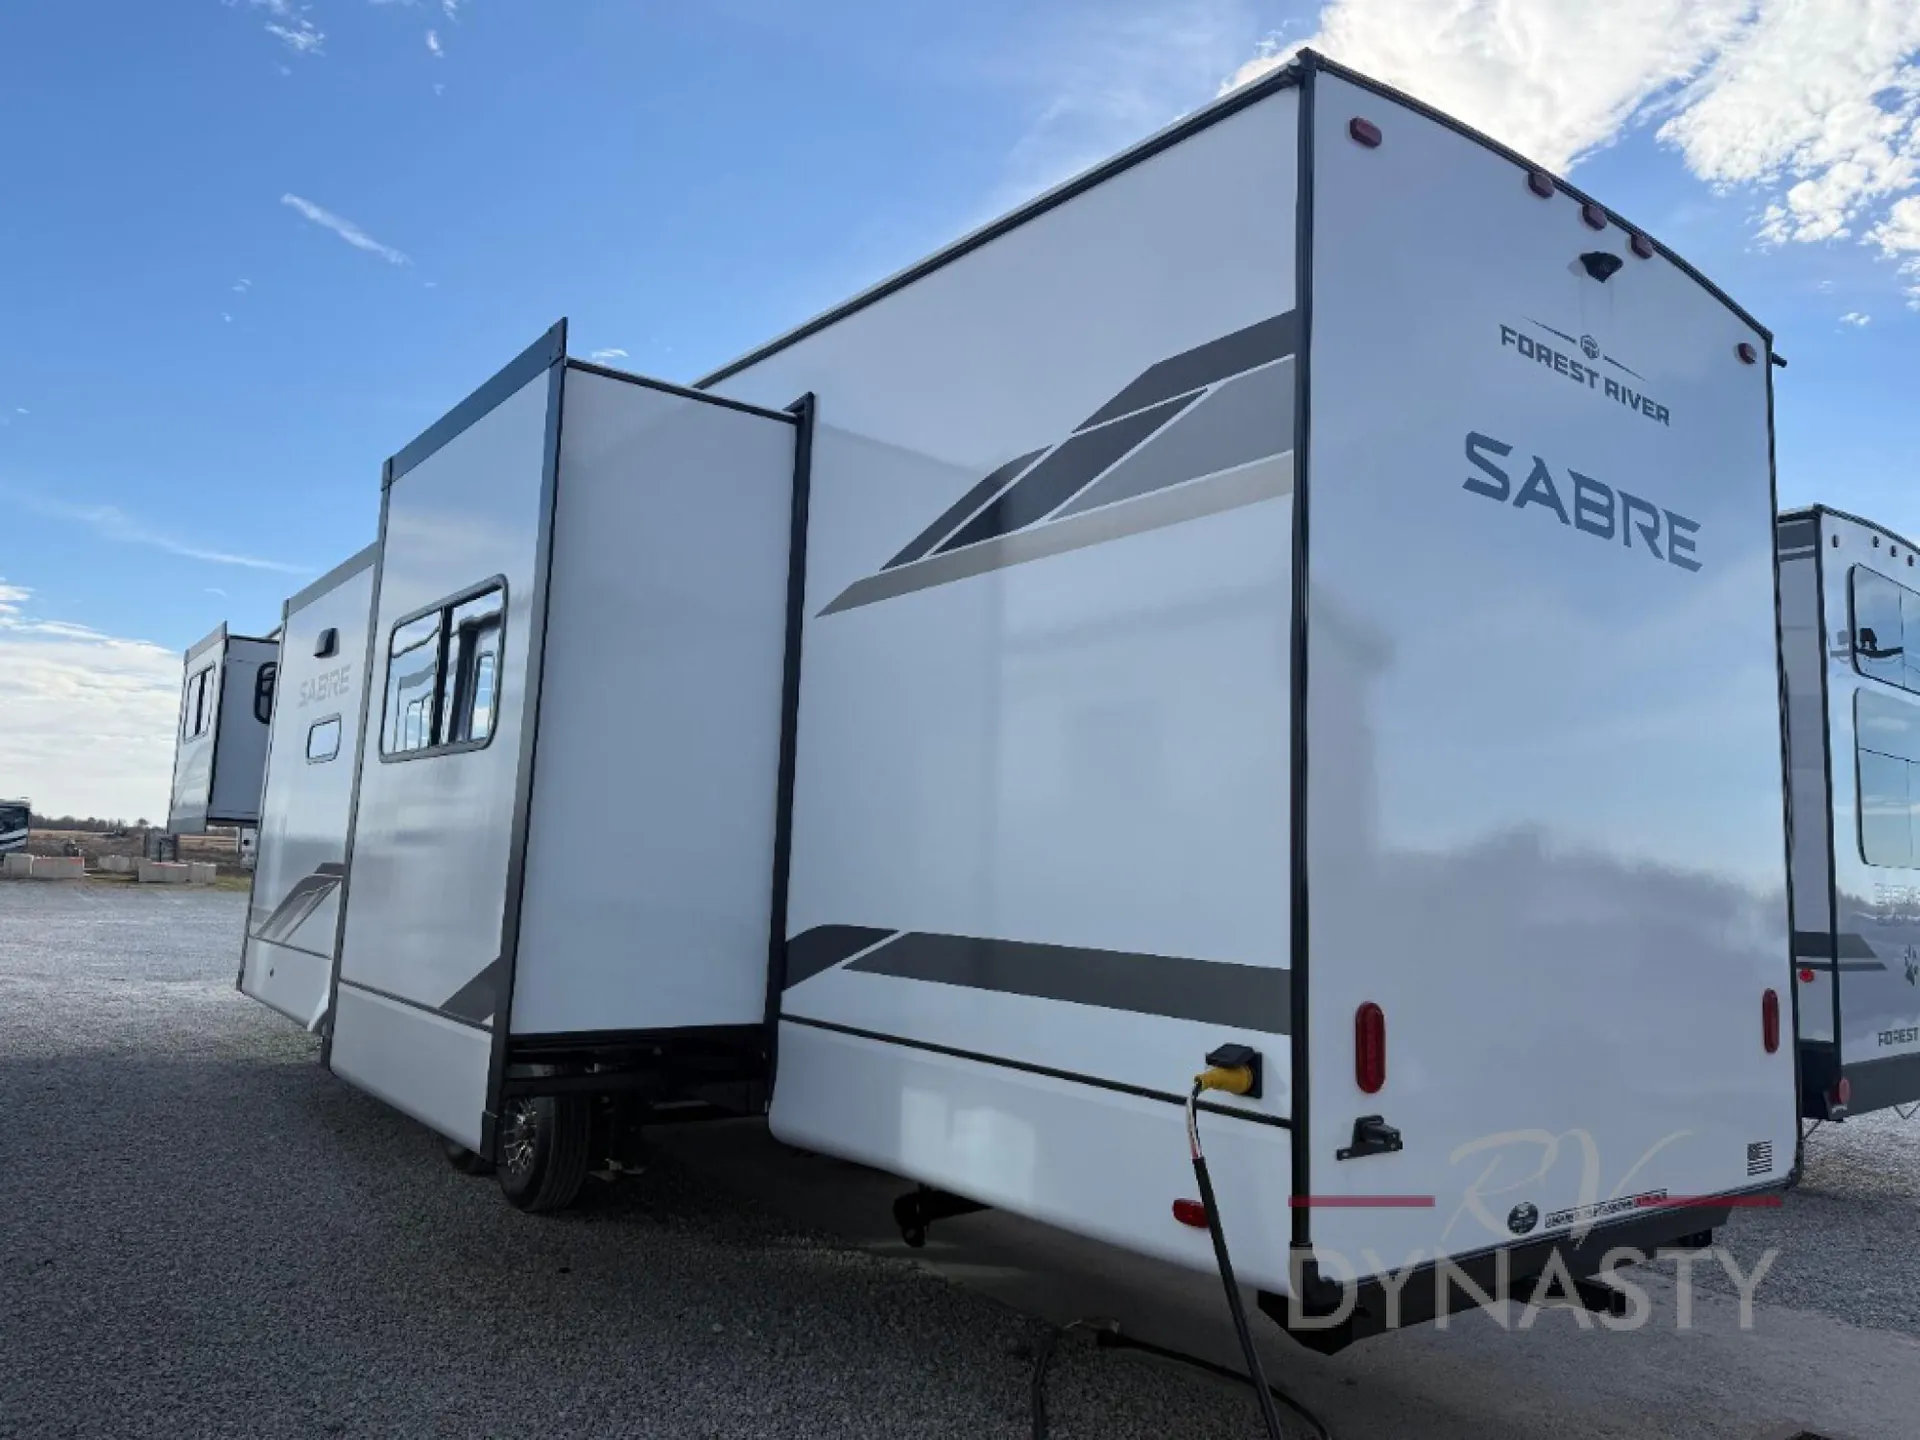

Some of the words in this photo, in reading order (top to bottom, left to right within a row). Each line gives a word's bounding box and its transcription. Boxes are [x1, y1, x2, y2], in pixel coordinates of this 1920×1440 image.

[1500, 324, 1599, 389] FOREST
[1604, 376, 1670, 426] RIVER
[1462, 430, 1702, 572] SABRE
[298, 663, 351, 708] SABRE
